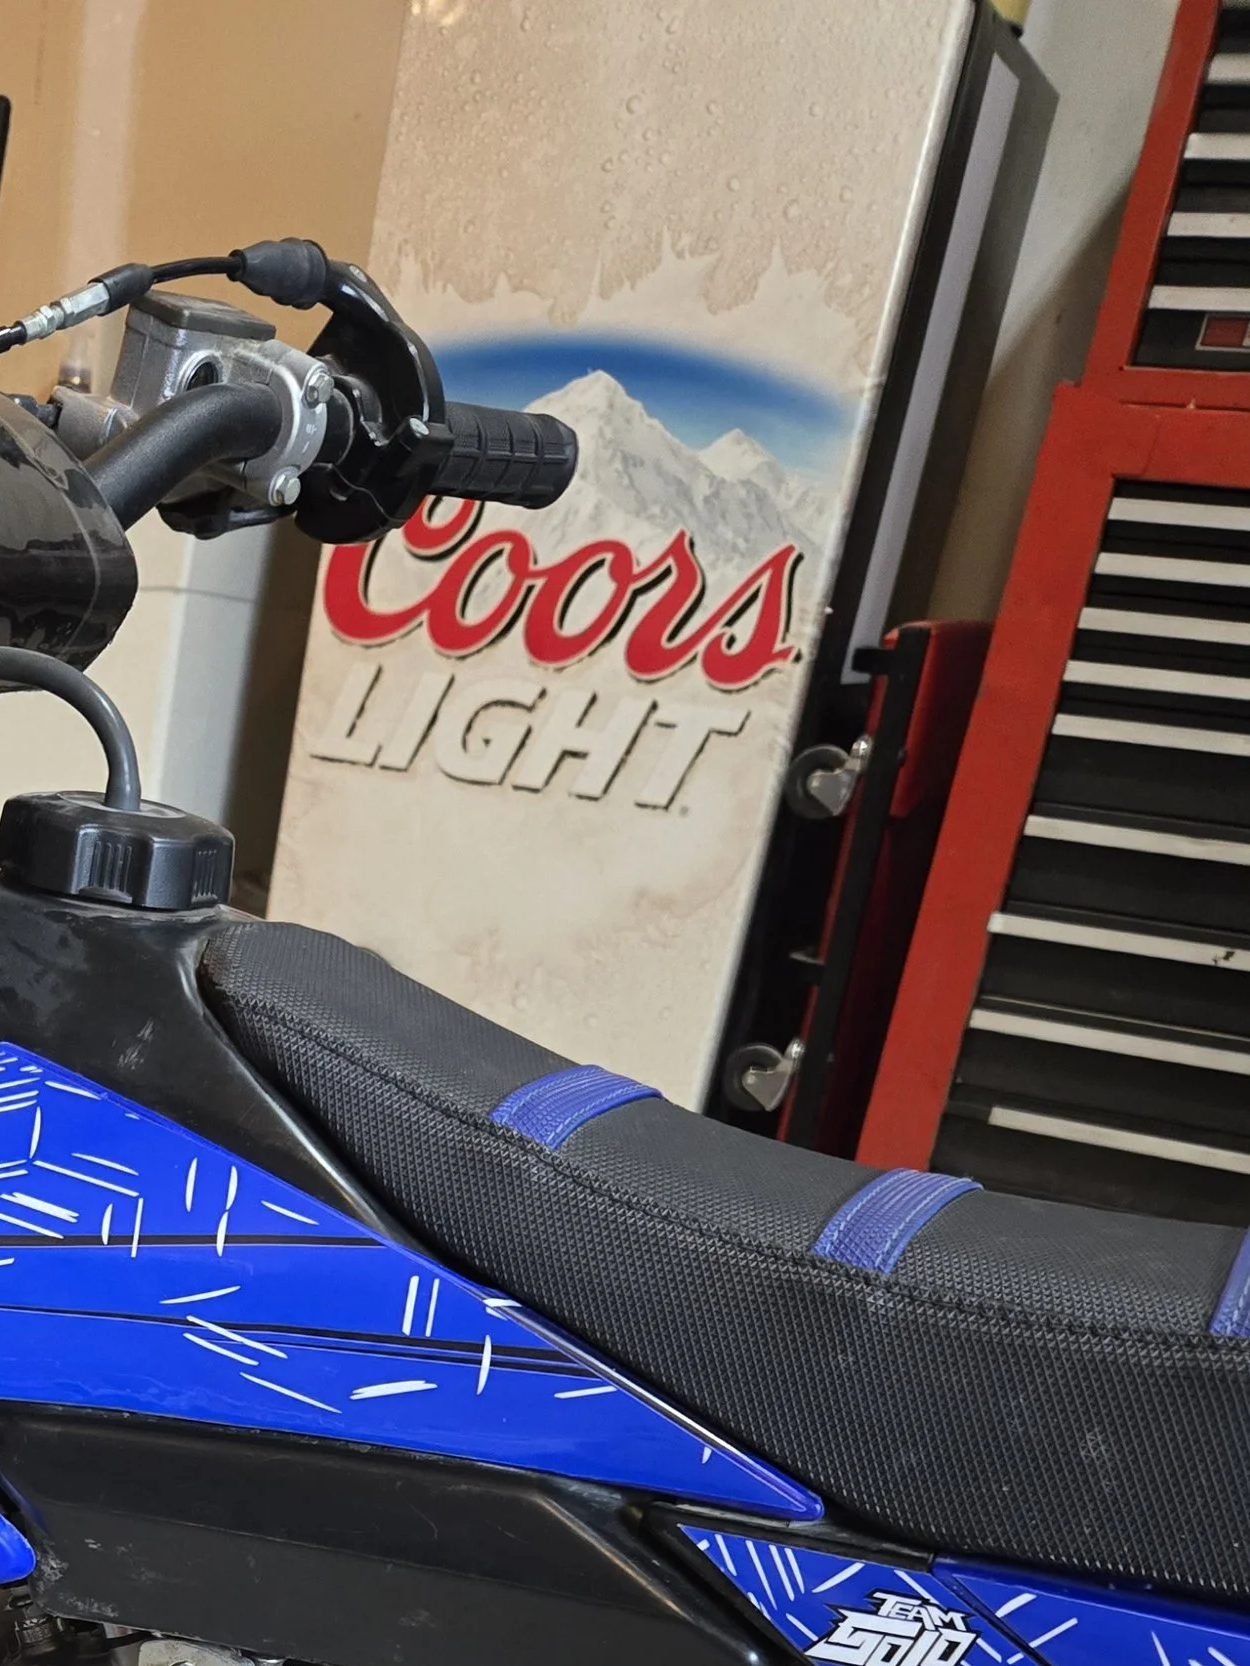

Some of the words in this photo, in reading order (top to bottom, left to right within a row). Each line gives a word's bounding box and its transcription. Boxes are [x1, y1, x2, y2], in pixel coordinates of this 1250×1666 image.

[323, 492, 802, 691] Coors
[308, 664, 751, 811] LIGHT
[871, 1590, 968, 1632] TEAM
